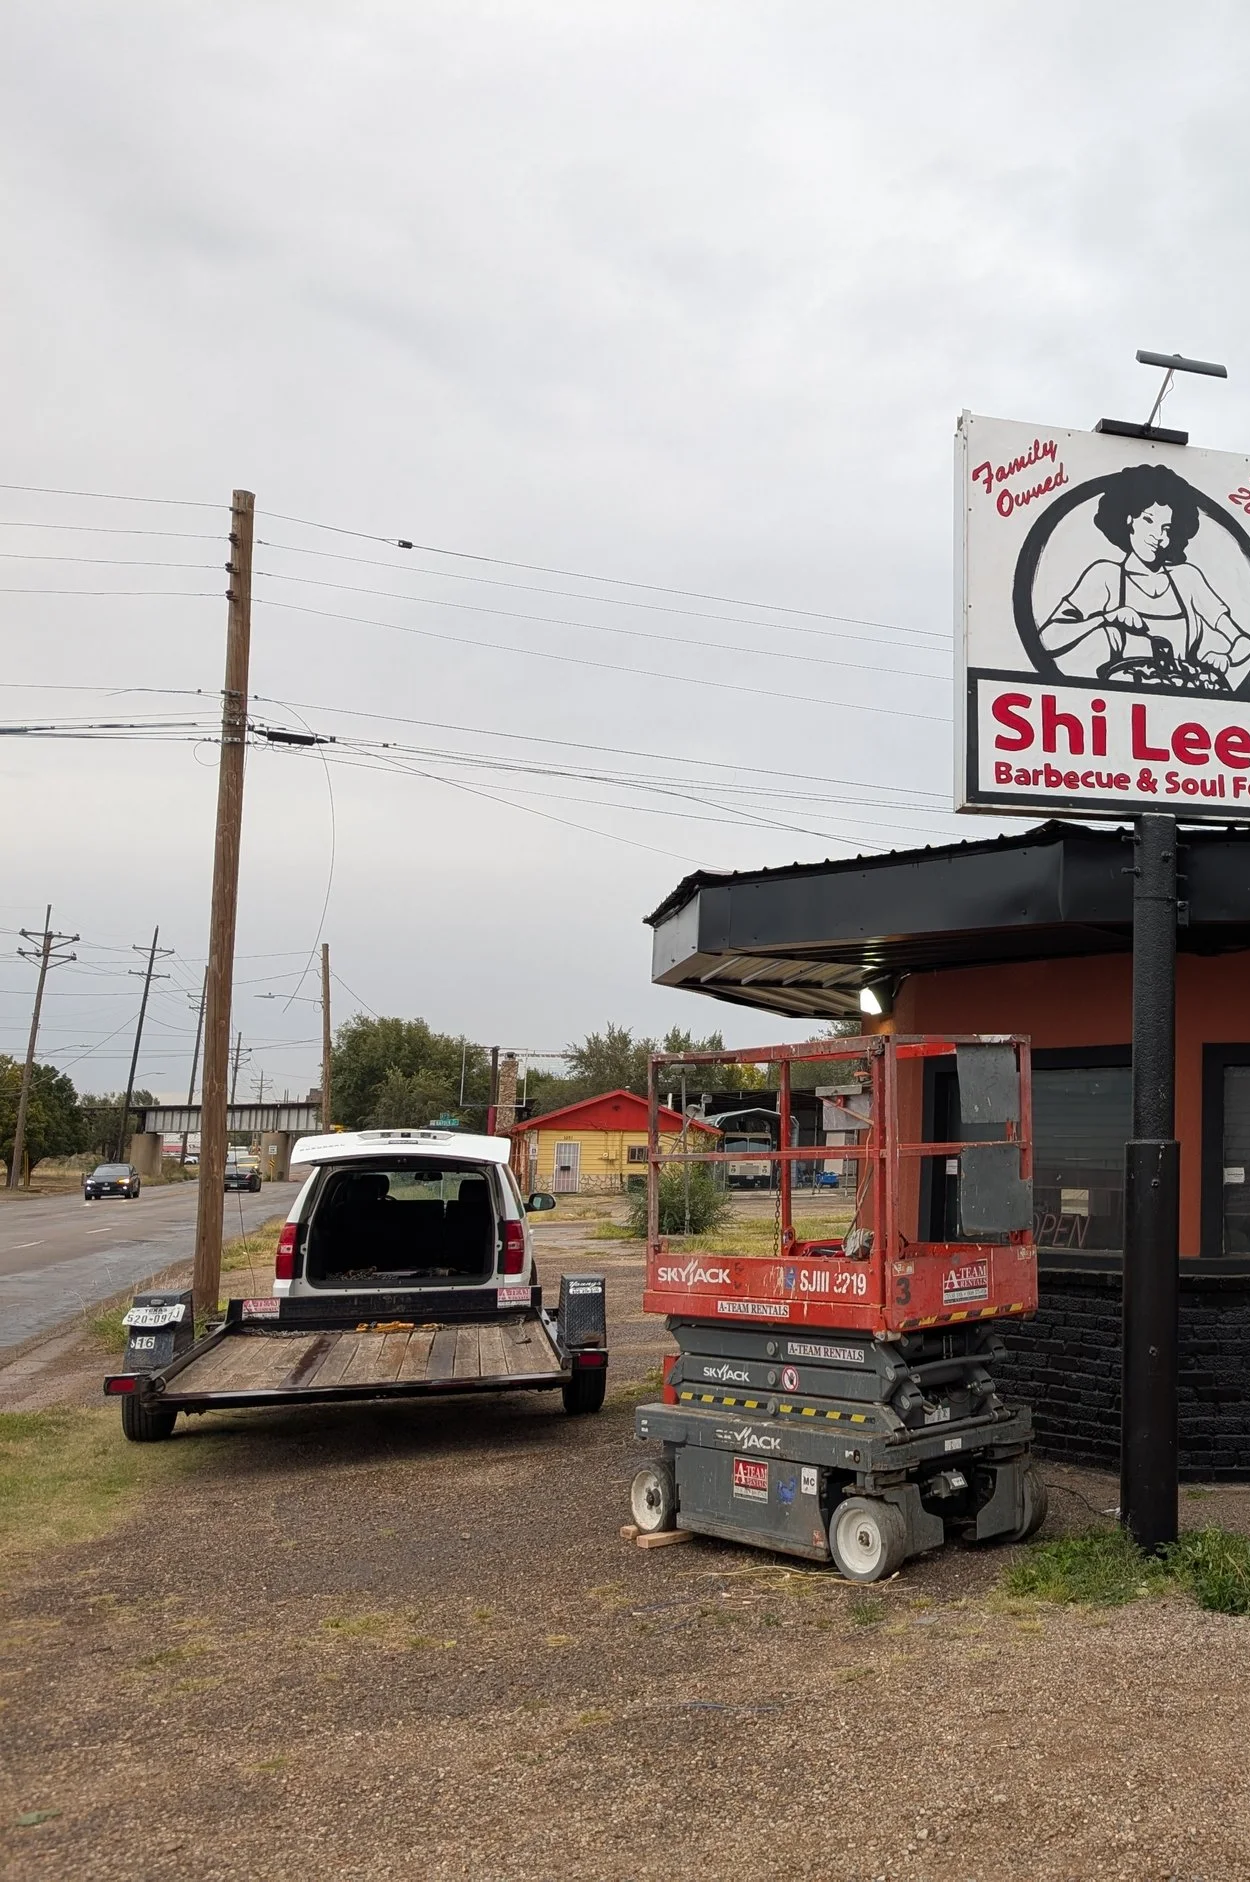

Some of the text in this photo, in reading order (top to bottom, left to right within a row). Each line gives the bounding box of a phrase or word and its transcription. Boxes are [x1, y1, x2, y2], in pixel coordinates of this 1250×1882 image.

[972, 439, 1058, 494] Family
[996, 462, 1069, 517] Owned
[992, 692, 1107, 757] Shi
[994, 761, 1131, 792] Barbecue
[1136, 767, 1158, 794] &
[1165, 771, 1226, 798] Soul
[657, 1259, 731, 1286] SKYJACK
[944, 1265, 987, 1290] A-TEAM
[960, 1277, 988, 1288] RENTALS
[896, 1277, 911, 1306] 3
[718, 1301, 788, 1317] A-TEAM RENTALS
[789, 1342, 864, 1361] A-TEAM RENTALS
[703, 1364, 750, 1382] SKYJACK
[803, 1476, 815, 1487] MC
